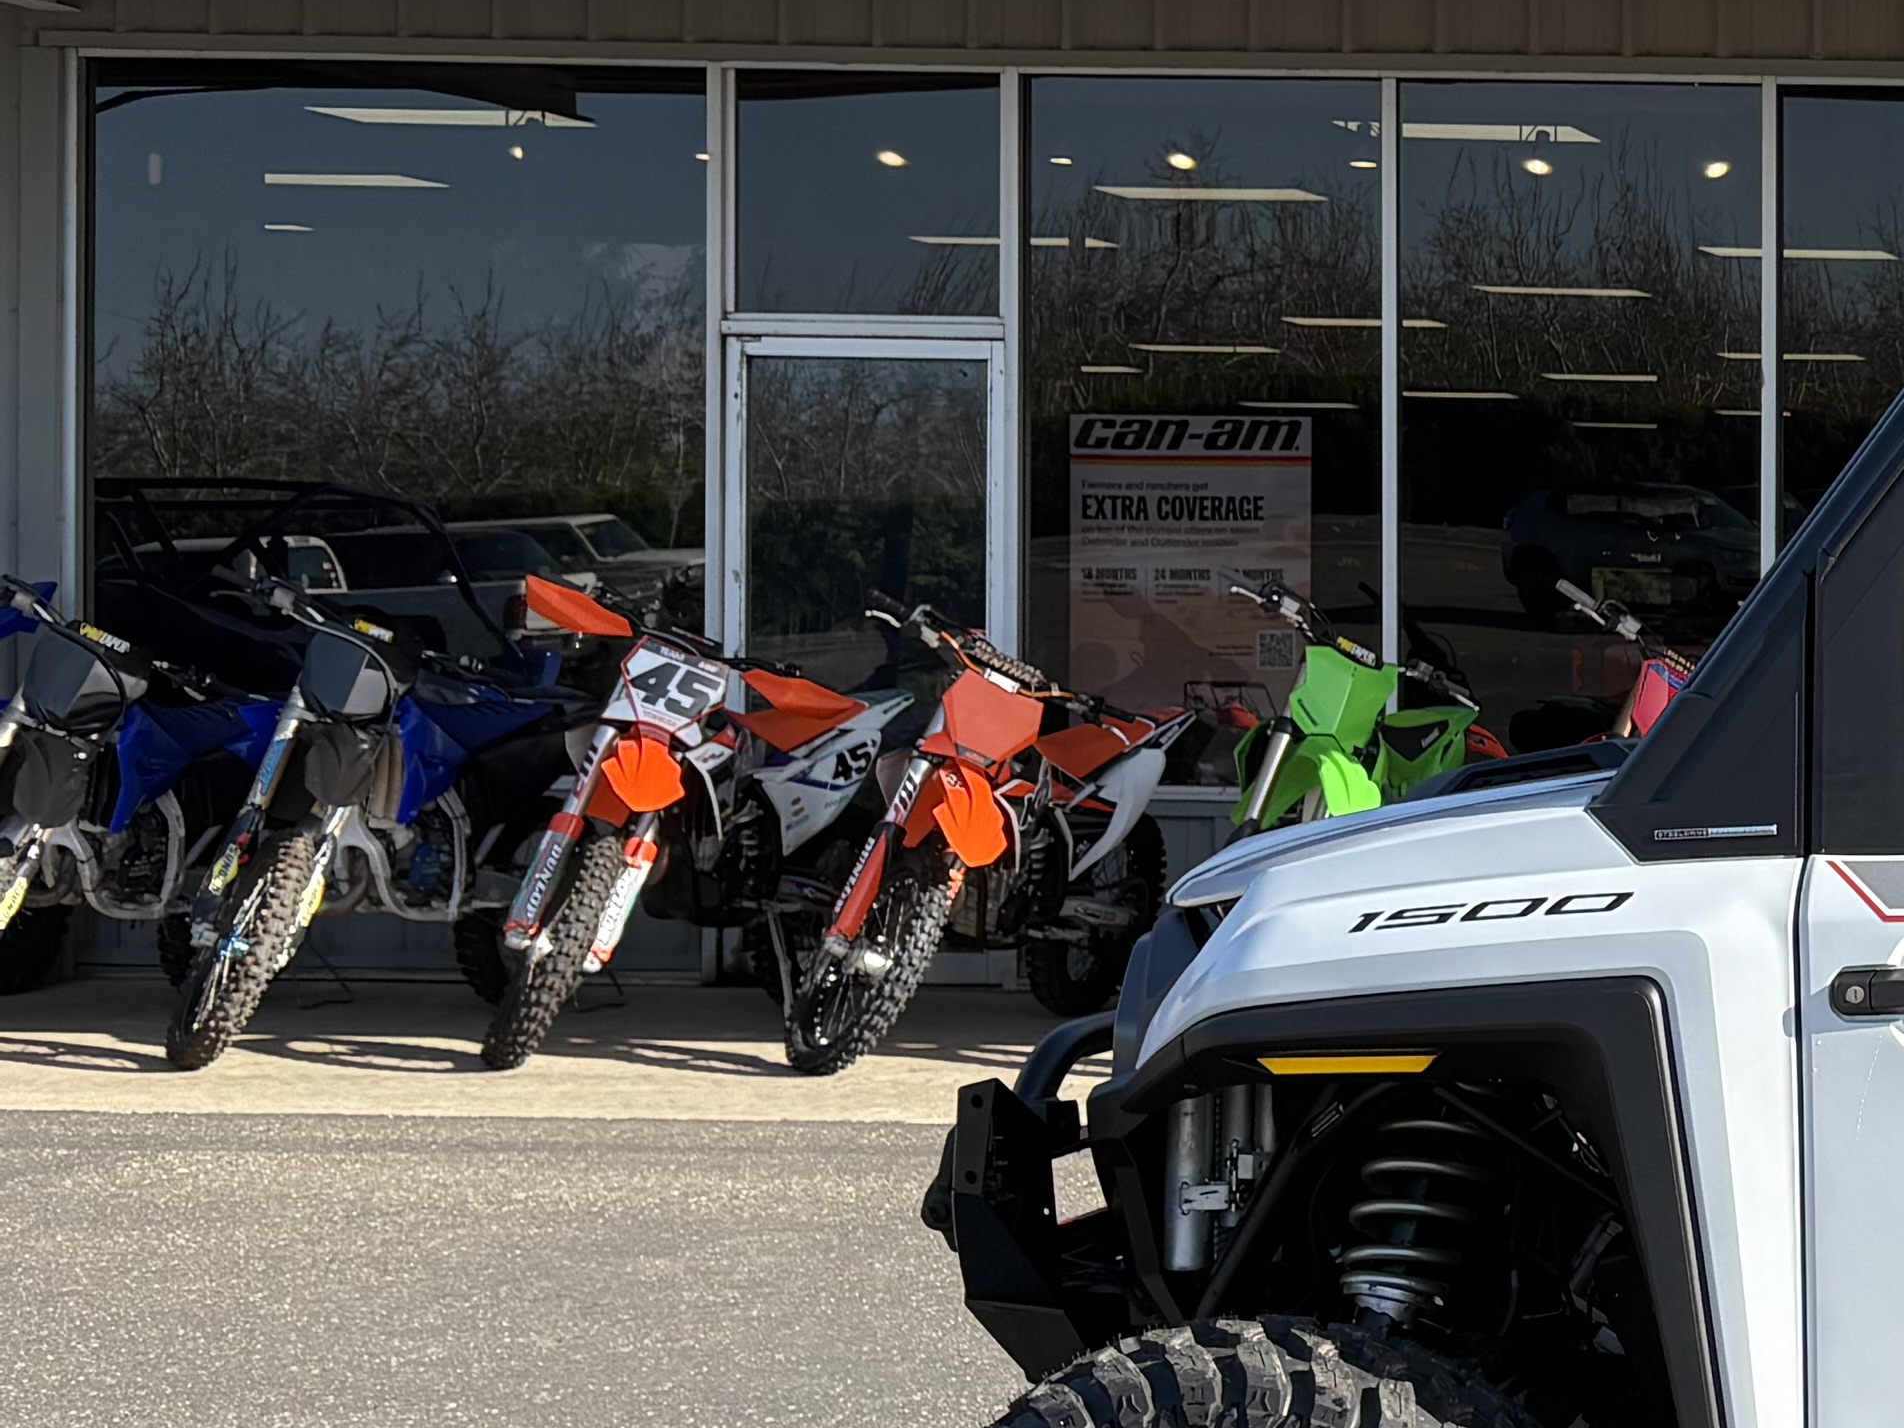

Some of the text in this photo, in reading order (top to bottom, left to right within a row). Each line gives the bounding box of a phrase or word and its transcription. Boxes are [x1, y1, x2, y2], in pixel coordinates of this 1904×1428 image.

[1073, 418, 1303, 452] can-am
[1082, 495, 1264, 521] EXTRA COVERAGE
[630, 662, 722, 719] 45
[832, 741, 871, 782] 45
[526, 843, 563, 919] DUNLOP
[1347, 891, 1635, 933] 1500
